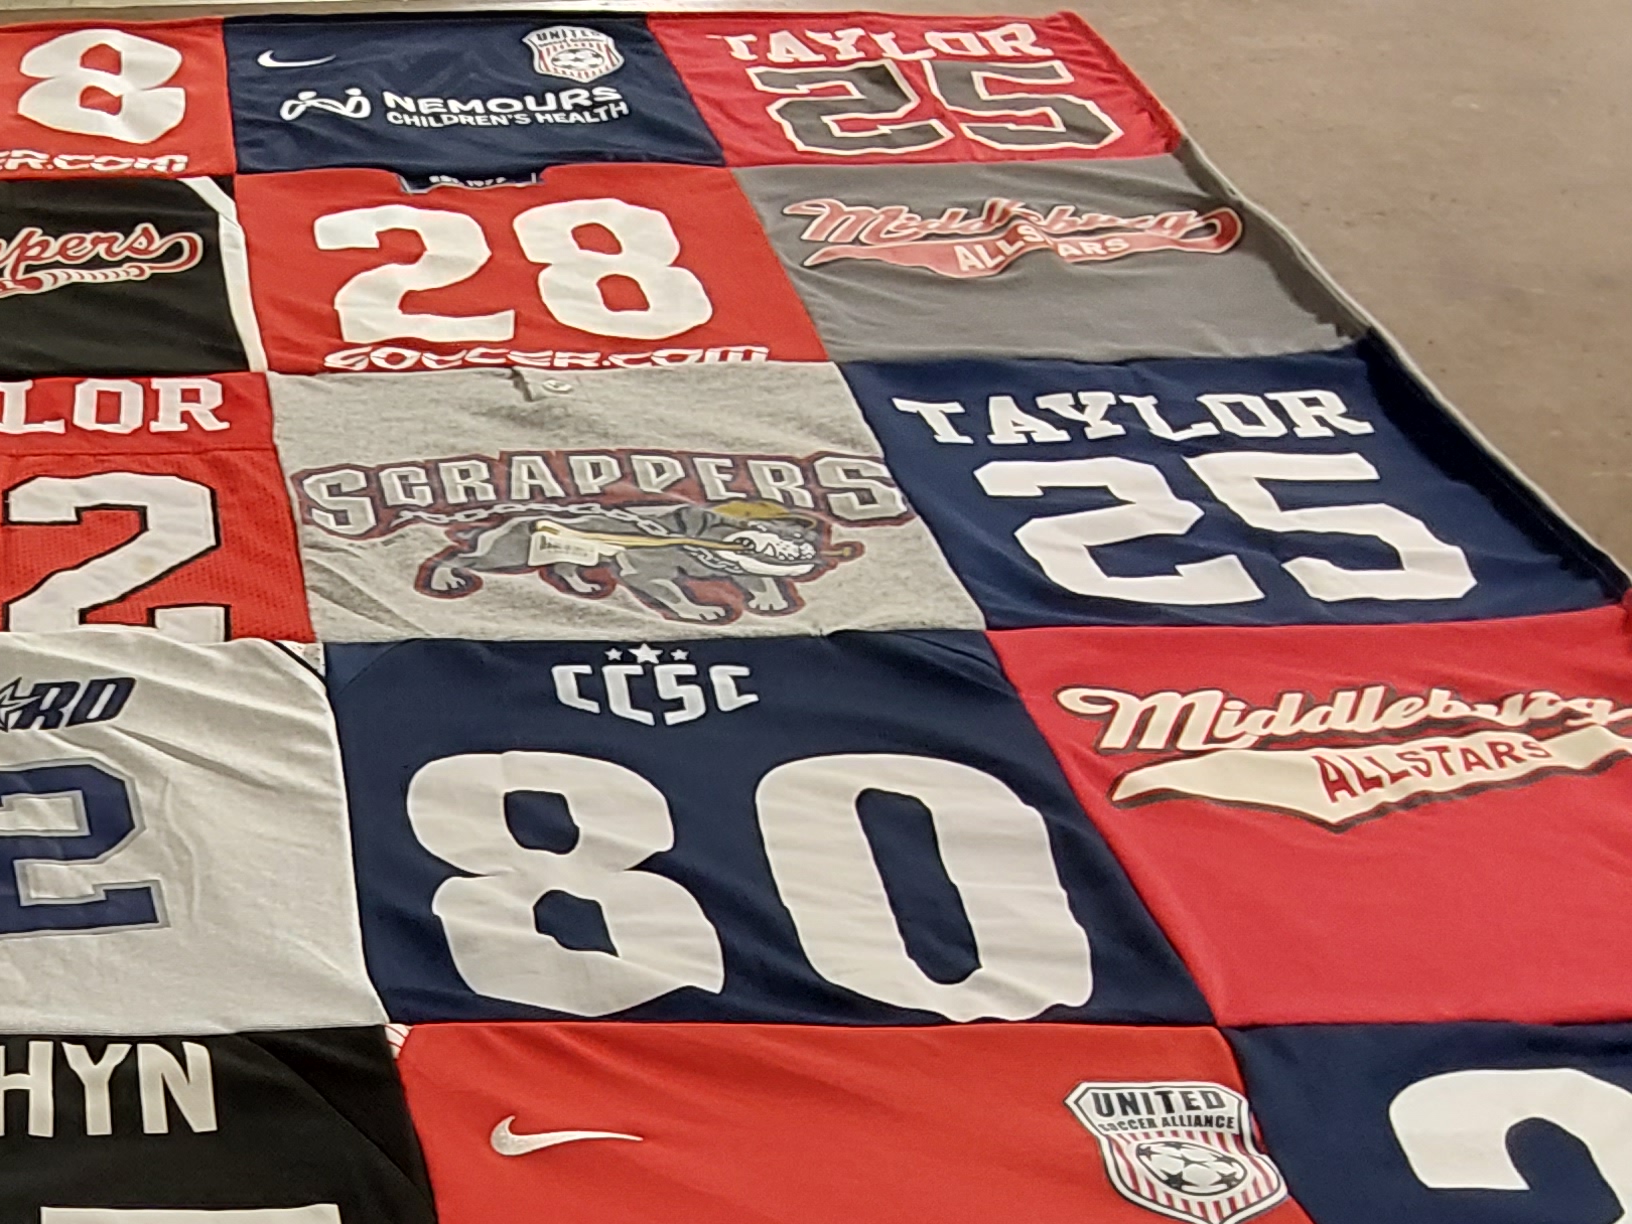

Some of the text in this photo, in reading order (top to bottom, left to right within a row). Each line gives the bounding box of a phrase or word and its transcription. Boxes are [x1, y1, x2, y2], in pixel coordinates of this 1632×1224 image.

[706, 23, 1054, 62] TAYLOR
[382, 86, 624, 115] NEMOURS
[386, 102, 630, 128] CHILDREN'S HEALTH
[746, 58, 1125, 156] 25
[313, 198, 713, 344] 28
[891, 389, 1374, 445] TAYLOR
[292, 449, 916, 539] SCRAPPERS
[973, 451, 1478, 605] 25
[551, 663, 759, 726] CCSC
[406, 750, 1094, 1022] 80
[1091, 1089, 1226, 1118] UNITED
[1097, 1115, 1236, 1132] SOCCER ALLIANCE
